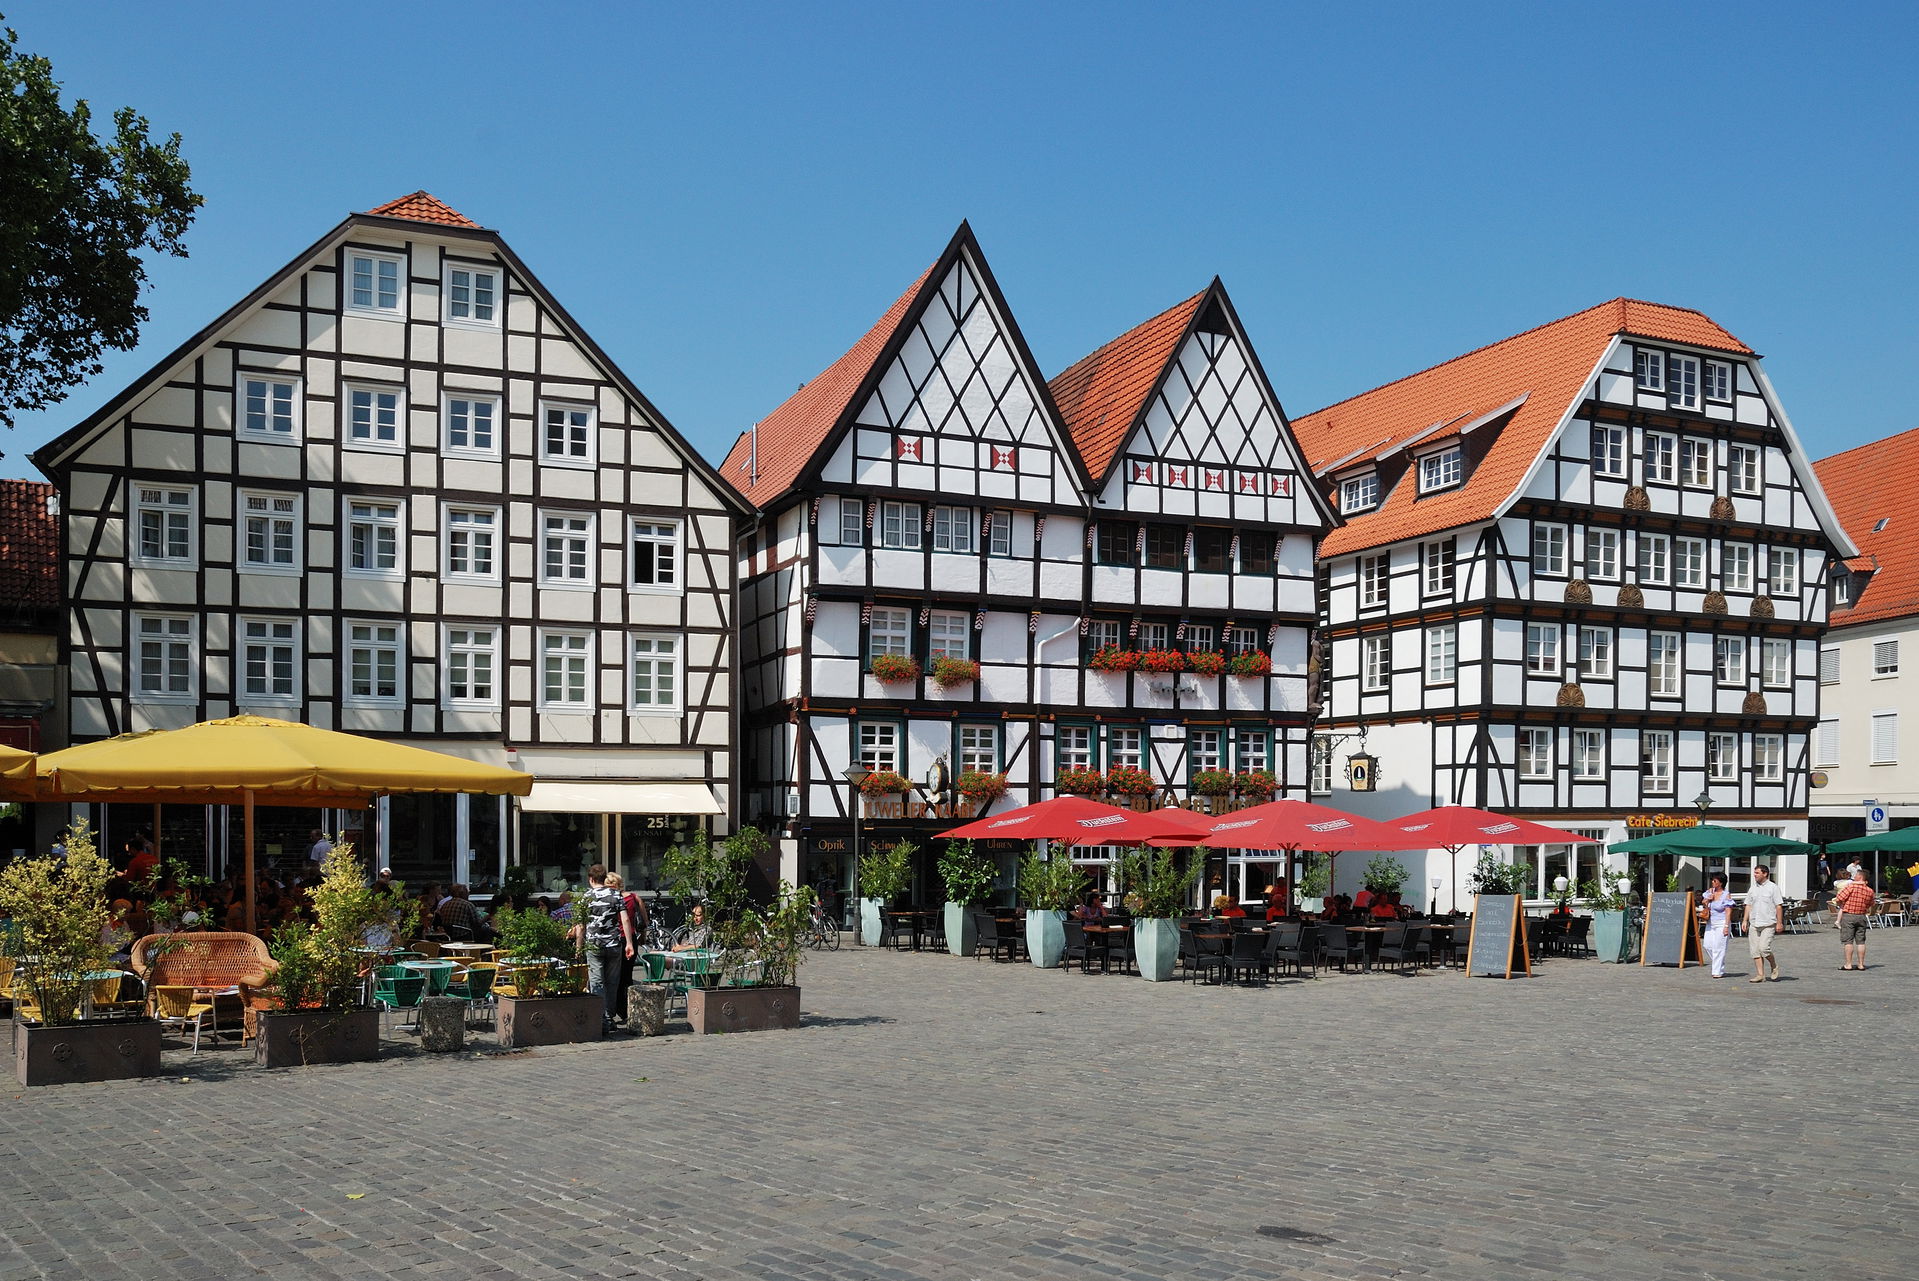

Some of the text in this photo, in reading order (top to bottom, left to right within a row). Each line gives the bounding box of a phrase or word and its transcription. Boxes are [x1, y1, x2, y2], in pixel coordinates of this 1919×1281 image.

[862, 801, 927, 820] JUWELIER
[647, 817, 664, 829] 25
[1626, 815, 1651, 828] Cafe
[818, 839, 846, 851] Optik
[870, 839, 898, 851] Schm
